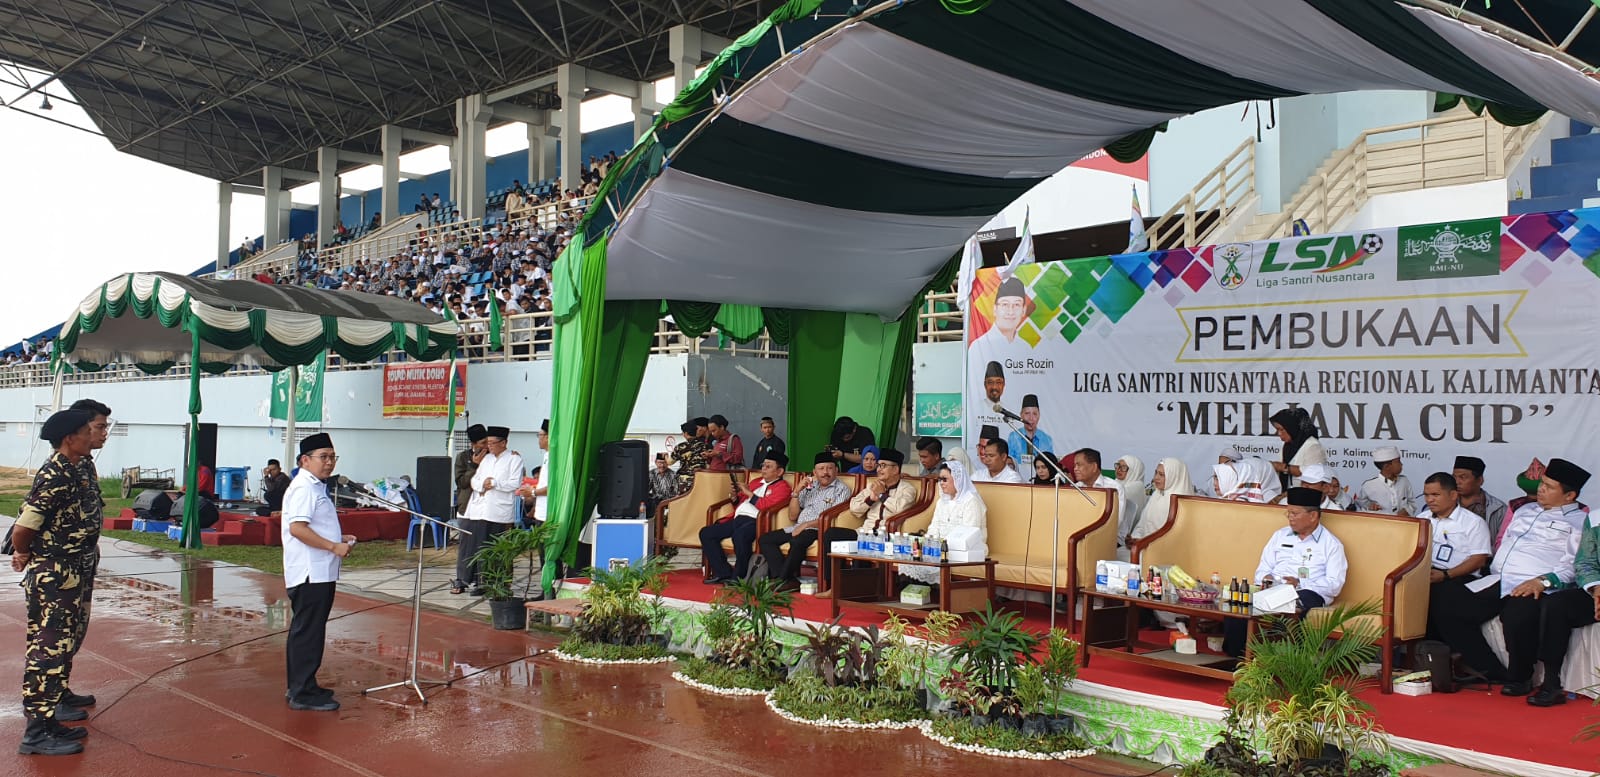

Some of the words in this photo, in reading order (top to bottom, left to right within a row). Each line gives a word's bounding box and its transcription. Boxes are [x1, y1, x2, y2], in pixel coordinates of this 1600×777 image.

[1258, 234, 1367, 273] LSN
[1429, 263, 1464, 273] RMI-NU
[1256, 278, 1279, 289] Liga
[1281, 274, 1313, 286] Santri
[1316, 271, 1375, 284] Nusantara
[1193, 303, 1501, 352] PEMBUKAAN
[1004, 358, 1024, 369] Gus
[1026, 358, 1054, 369] Rozin
[1073, 372, 1113, 393] LIGA
[1117, 372, 1185, 393] SANTRI
[1190, 371, 1311, 394] NUSANTARA
[1317, 369, 1435, 394] REGIONAL
[1441, 368, 1600, 395] KALIMANTA
[1156, 401, 1404, 441] “MEILANA
[1400, 449, 1431, 460] Timur,
[1342, 460, 1367, 469] 2019
